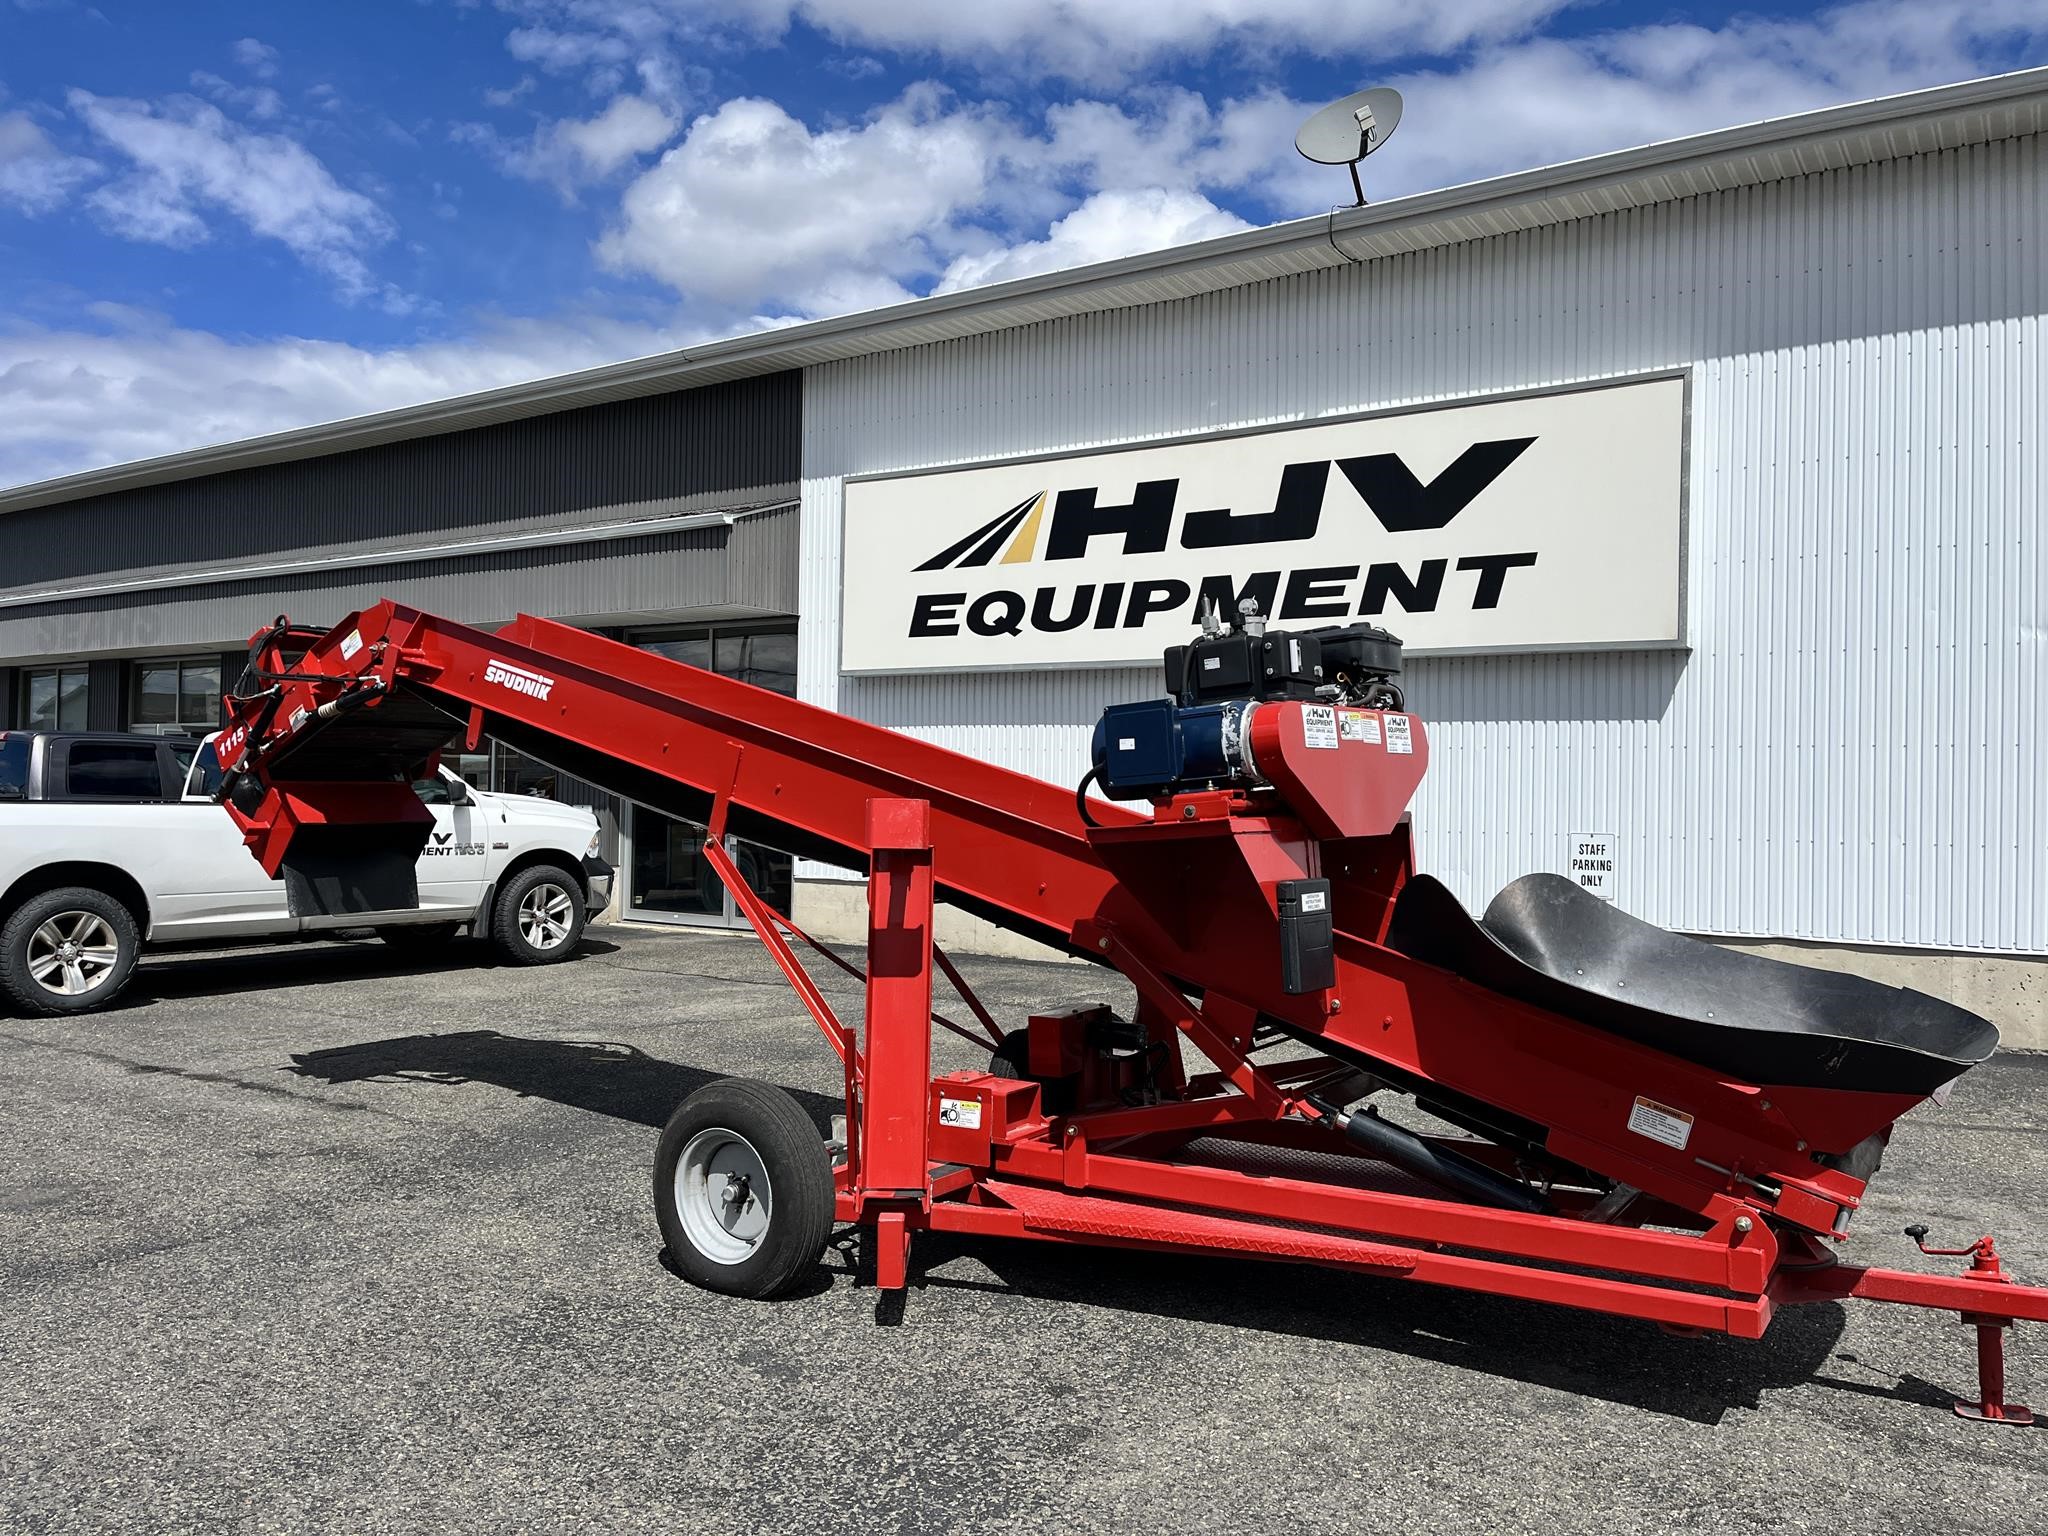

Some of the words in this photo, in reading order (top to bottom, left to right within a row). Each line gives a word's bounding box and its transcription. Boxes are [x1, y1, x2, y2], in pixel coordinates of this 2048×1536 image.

[1045, 436, 1539, 561] HJV
[908, 552, 1538, 637] EQUIPMENT
[484, 664, 552, 701] SPUDNIK
[1312, 708, 1331, 718] HJV
[1306, 718, 1333, 727] EQUIPMENT
[1392, 717, 1406, 726] HJV
[219, 727, 244, 757] 1115
[1579, 843, 1606, 855] STAFF
[1572, 859, 1612, 871] PARKING
[1581, 874, 1603, 887] ONLY
